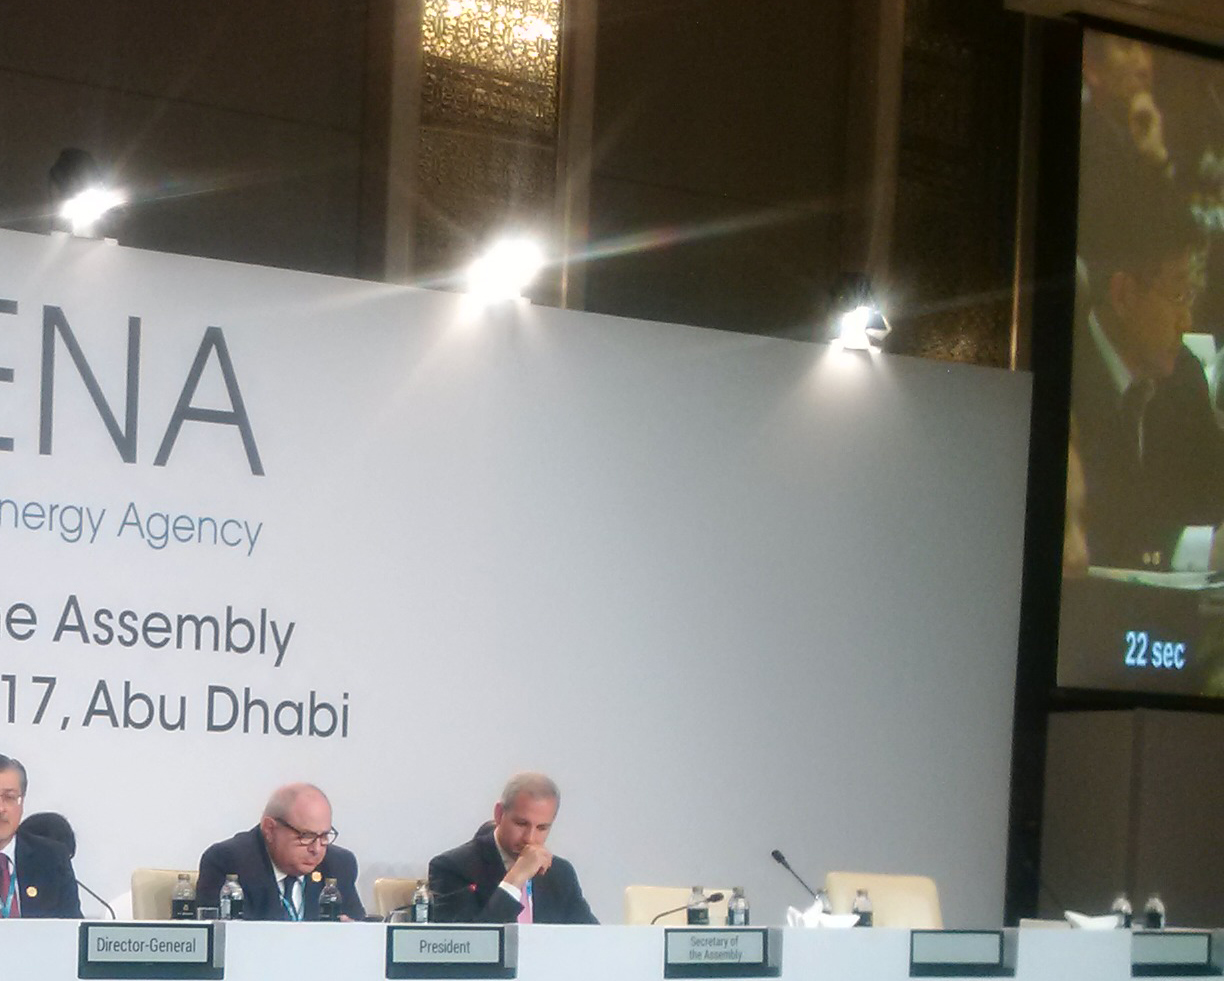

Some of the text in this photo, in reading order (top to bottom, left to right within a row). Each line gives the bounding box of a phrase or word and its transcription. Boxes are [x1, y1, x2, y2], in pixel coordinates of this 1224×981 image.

[116, 501, 264, 557] Agency
[51, 594, 297, 668] Assembly
[1124, 630, 1187, 670] 22 sec
[81, 678, 187, 732] Abu
[206, 684, 351, 739] Dhabi
[96, 936, 196, 953] Director-General
[419, 938, 471, 954] President
[689, 949, 743, 963] the Assembly
[690, 935, 739, 949] Secretary of
